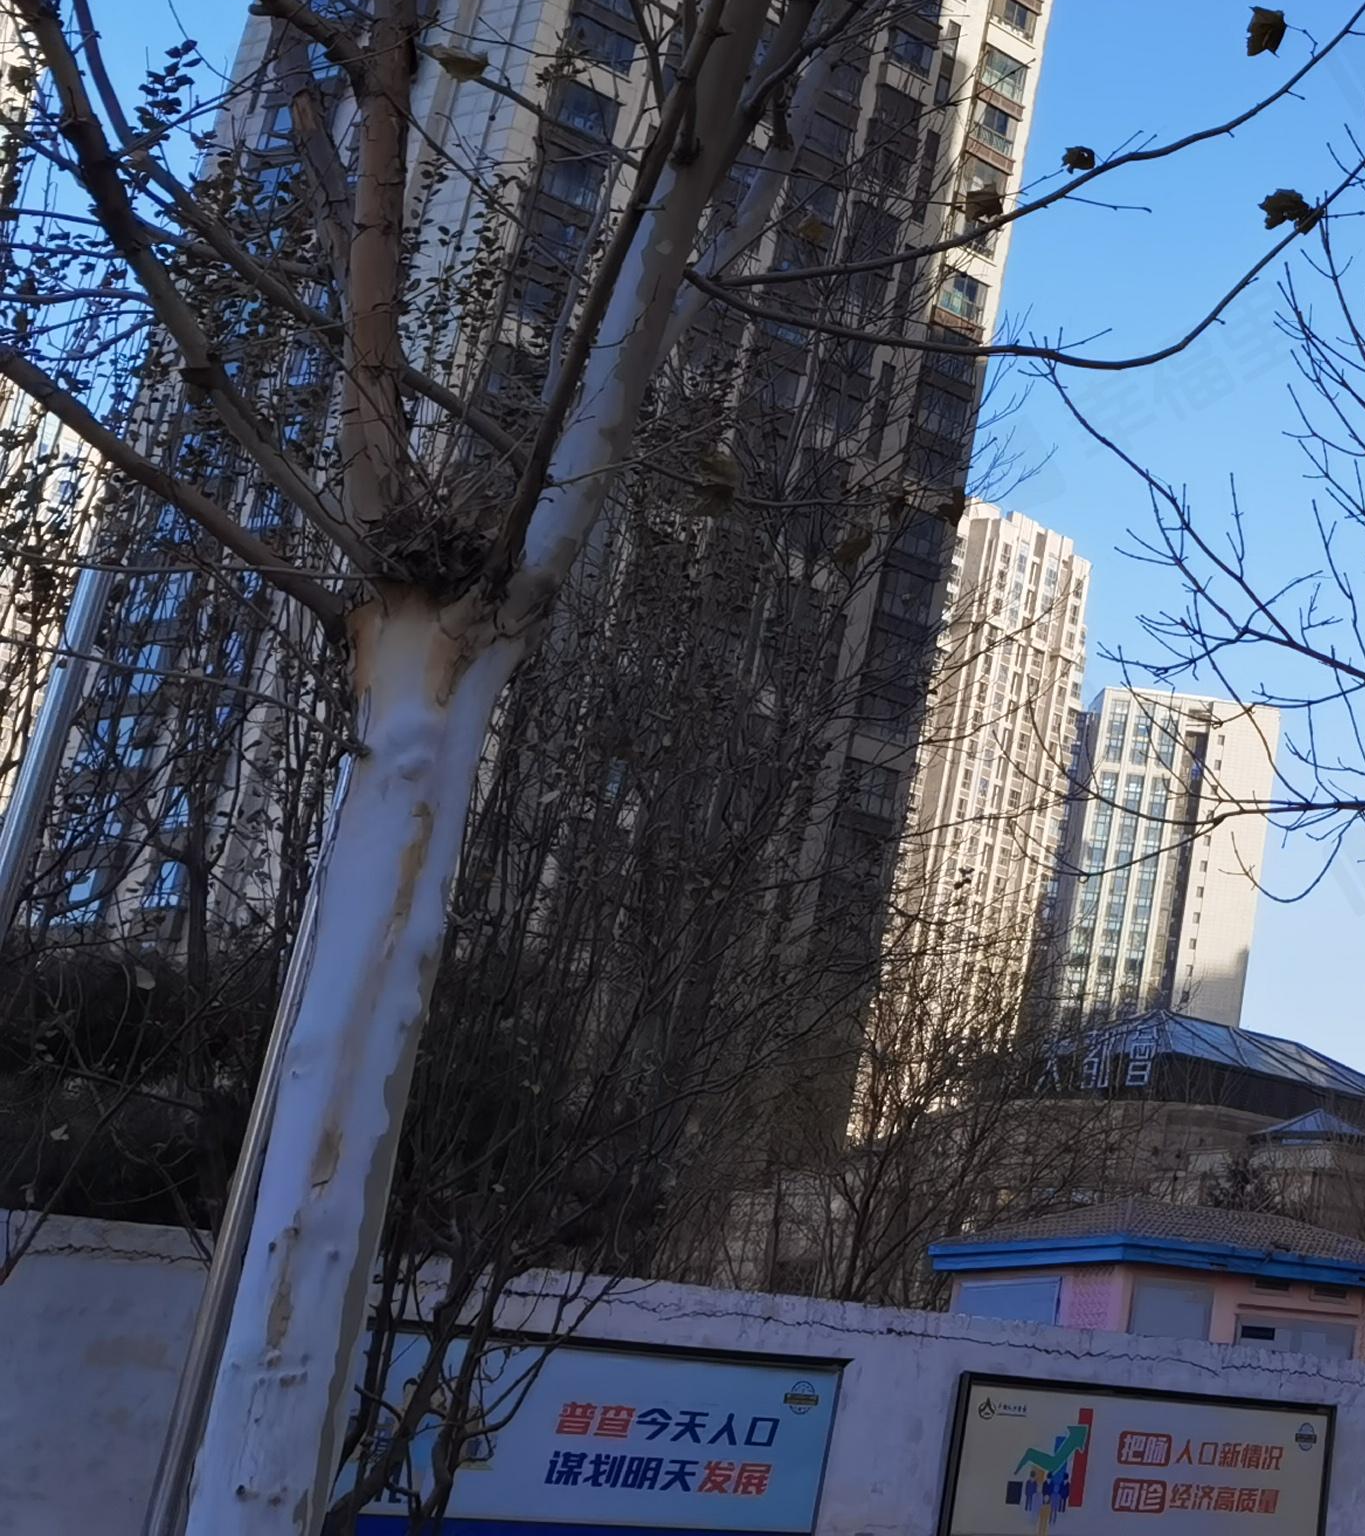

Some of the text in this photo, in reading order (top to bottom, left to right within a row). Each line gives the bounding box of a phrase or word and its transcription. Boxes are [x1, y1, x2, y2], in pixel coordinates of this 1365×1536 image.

[555, 1401, 780, 1448] 普查今天人口
[544, 1450, 773, 1496] 谋划明天发展
